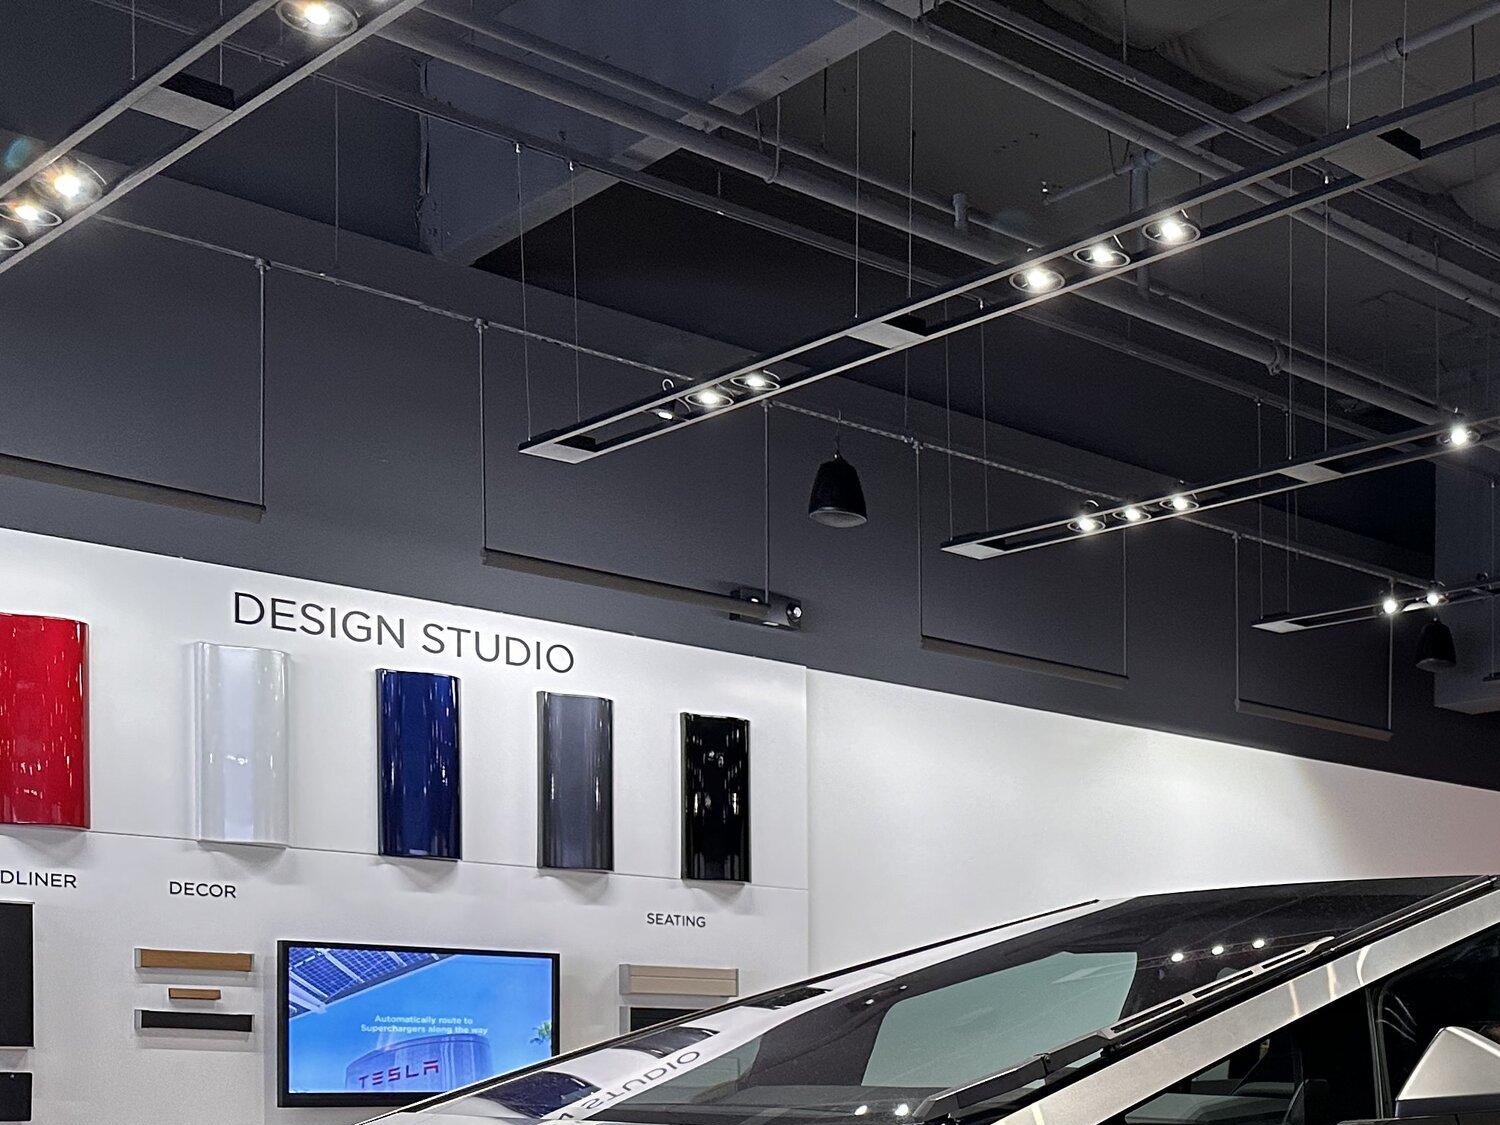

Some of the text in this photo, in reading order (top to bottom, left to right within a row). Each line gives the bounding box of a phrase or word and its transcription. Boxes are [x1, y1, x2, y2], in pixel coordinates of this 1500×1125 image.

[234, 591, 575, 674] DESIGN STUDIO
[0, 869, 77, 889] DLINER
[169, 881, 236, 899] DECOR
[646, 912, 706, 928] SEATING
[374, 1014, 474, 1025] Automatically route to
[360, 1023, 488, 1036] Superchargers along the way
[358, 1059, 439, 1089] TESLA
